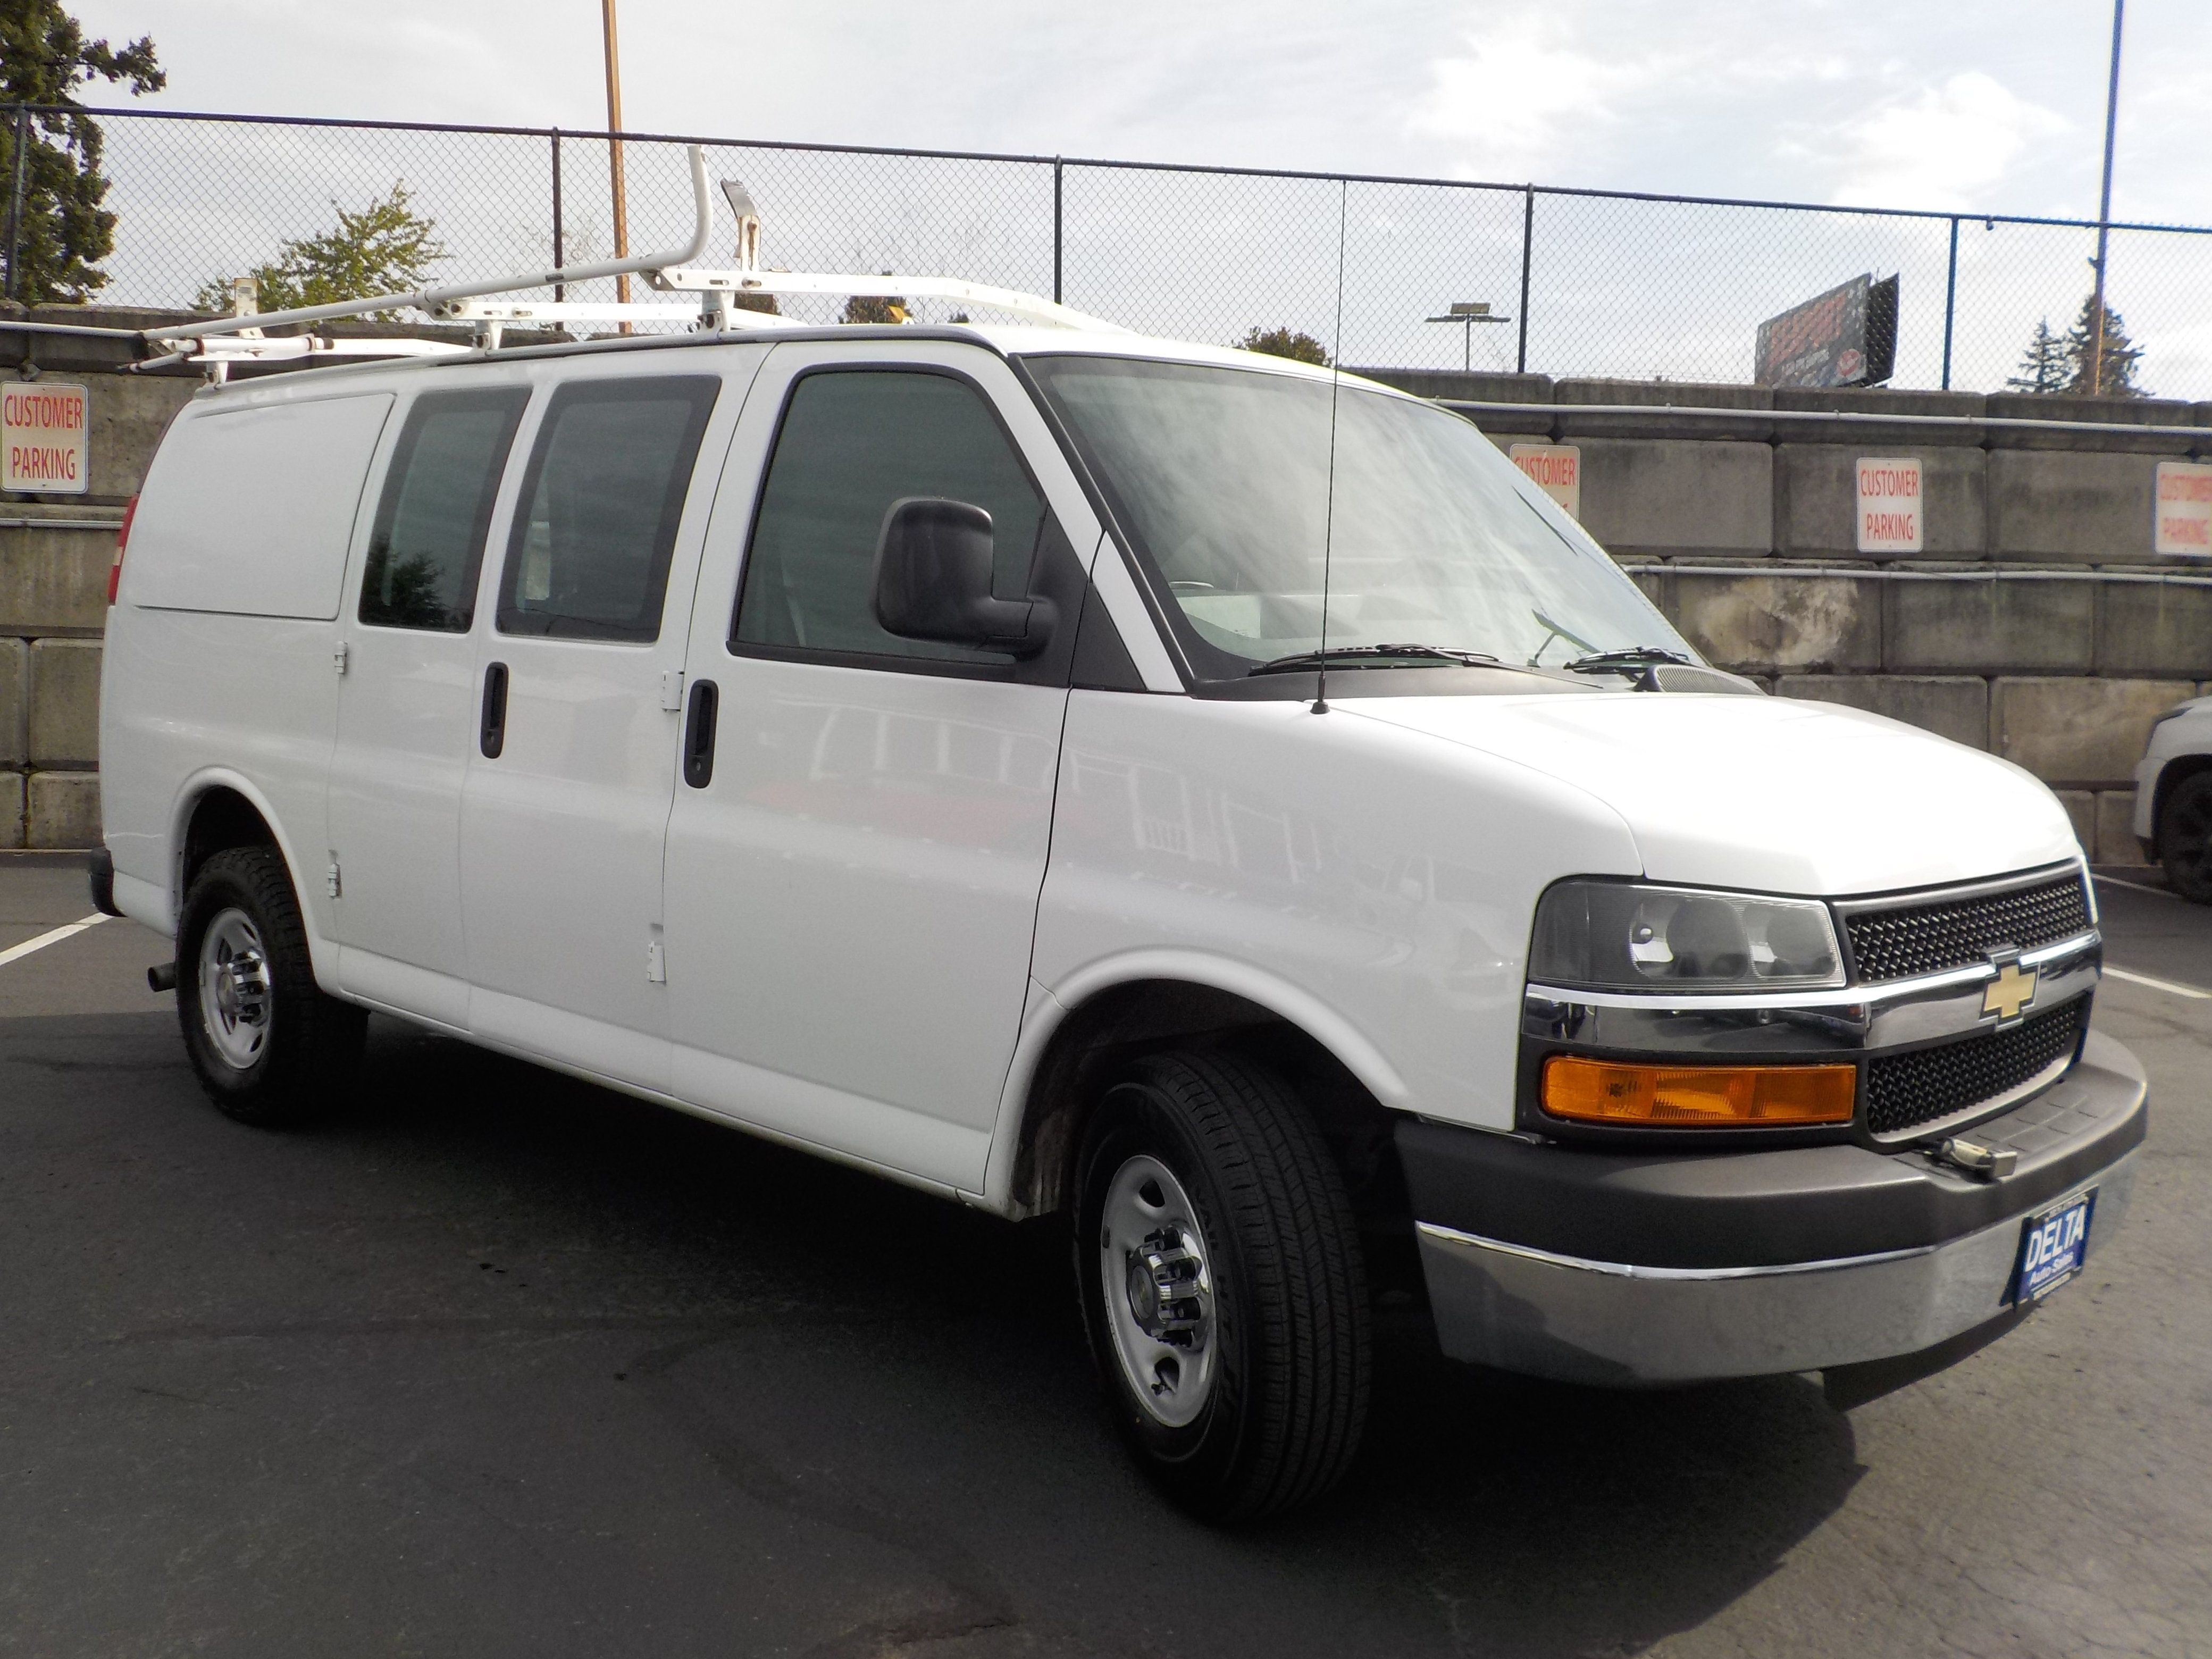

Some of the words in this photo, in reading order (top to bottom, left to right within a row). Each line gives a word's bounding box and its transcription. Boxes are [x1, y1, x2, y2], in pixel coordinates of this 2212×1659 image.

[4, 395, 83, 429] CUSTOMER
[12, 446, 76, 480] PARKING
[1514, 456, 1576, 485] USTOMER
[1861, 468, 1918, 497] CUSTOMER
[1866, 513, 1914, 540] PARKING
[2024, 1204, 2086, 1272] DELTA
